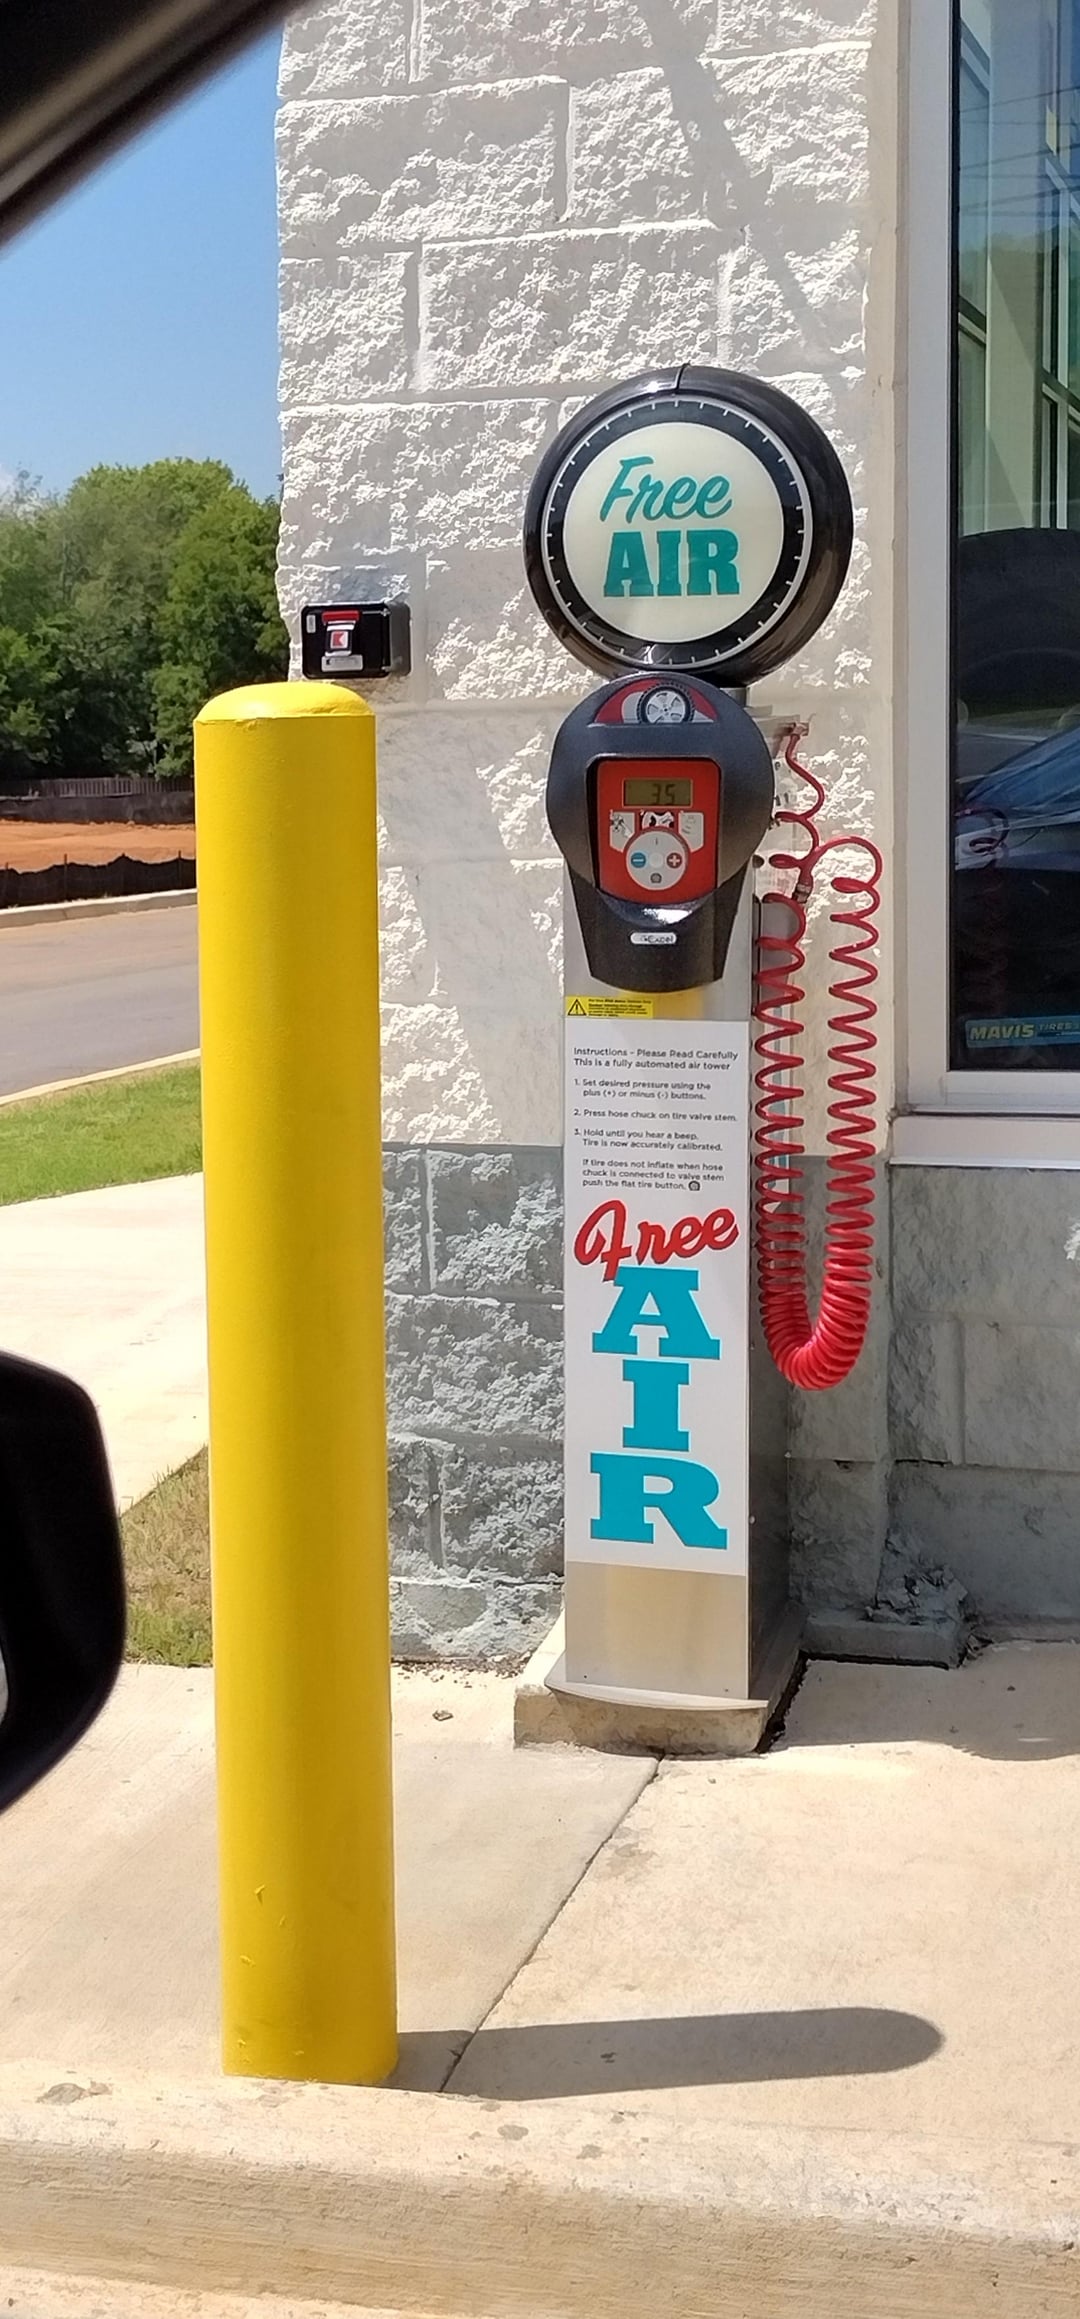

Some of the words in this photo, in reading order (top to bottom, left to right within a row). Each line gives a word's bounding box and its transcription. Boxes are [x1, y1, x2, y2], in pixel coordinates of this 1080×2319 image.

[600, 456, 732, 523] Free
[604, 529, 740, 597] AIR
[970, 1024, 1034, 1040] MAVIS
[573, 1047, 628, 1056] Instructions
[637, 1048, 667, 1057] Please
[670, 1049, 694, 1058] Read
[696, 1050, 739, 1061] Carefully
[574, 1058, 593, 1066] This
[595, 1058, 603, 1066] is
[613, 1059, 633, 1069] fully
[635, 1060, 686, 1069] automated
[703, 1062, 730, 1070] tower
[633, 1081, 669, 1089] pressure
[671, 1082, 694, 1090] using
[583, 1089, 601, 1097] plus
[671, 1092, 706, 1100] buttons.
[574, 1108, 581, 1116] 2.
[584, 1109, 606, 1117] Press
[608, 1110, 629, 1118] hose
[631, 1110, 656, 1118] chuck
[672, 1112, 687, 1120] tire
[689, 1113, 712, 1121] valve
[583, 1129, 604, 1137] Hold
[627, 1131, 643, 1139] you
[674, 1132, 699, 1140] beep.
[582, 1138, 599, 1146] Tire
[601, 1139, 607, 1147] is
[630, 1141, 674, 1150] accurately
[677, 1142, 723, 1151] calibrated.
[591, 1159, 605, 1167] tire
[607, 1160, 628, 1168] does
[647, 1161, 674, 1169] inflate
[677, 1162, 700, 1170] when
[702, 1163, 724, 1171] hose
[582, 1169, 607, 1177] chuck
[619, 1171, 664, 1179] connected
[678, 1173, 700, 1181] valve
[621, 1180, 635, 1188] flat
[655, 1181, 686, 1190] button.
[574, 1200, 739, 1282] Free
[590, 1266, 728, 1550] AIR
